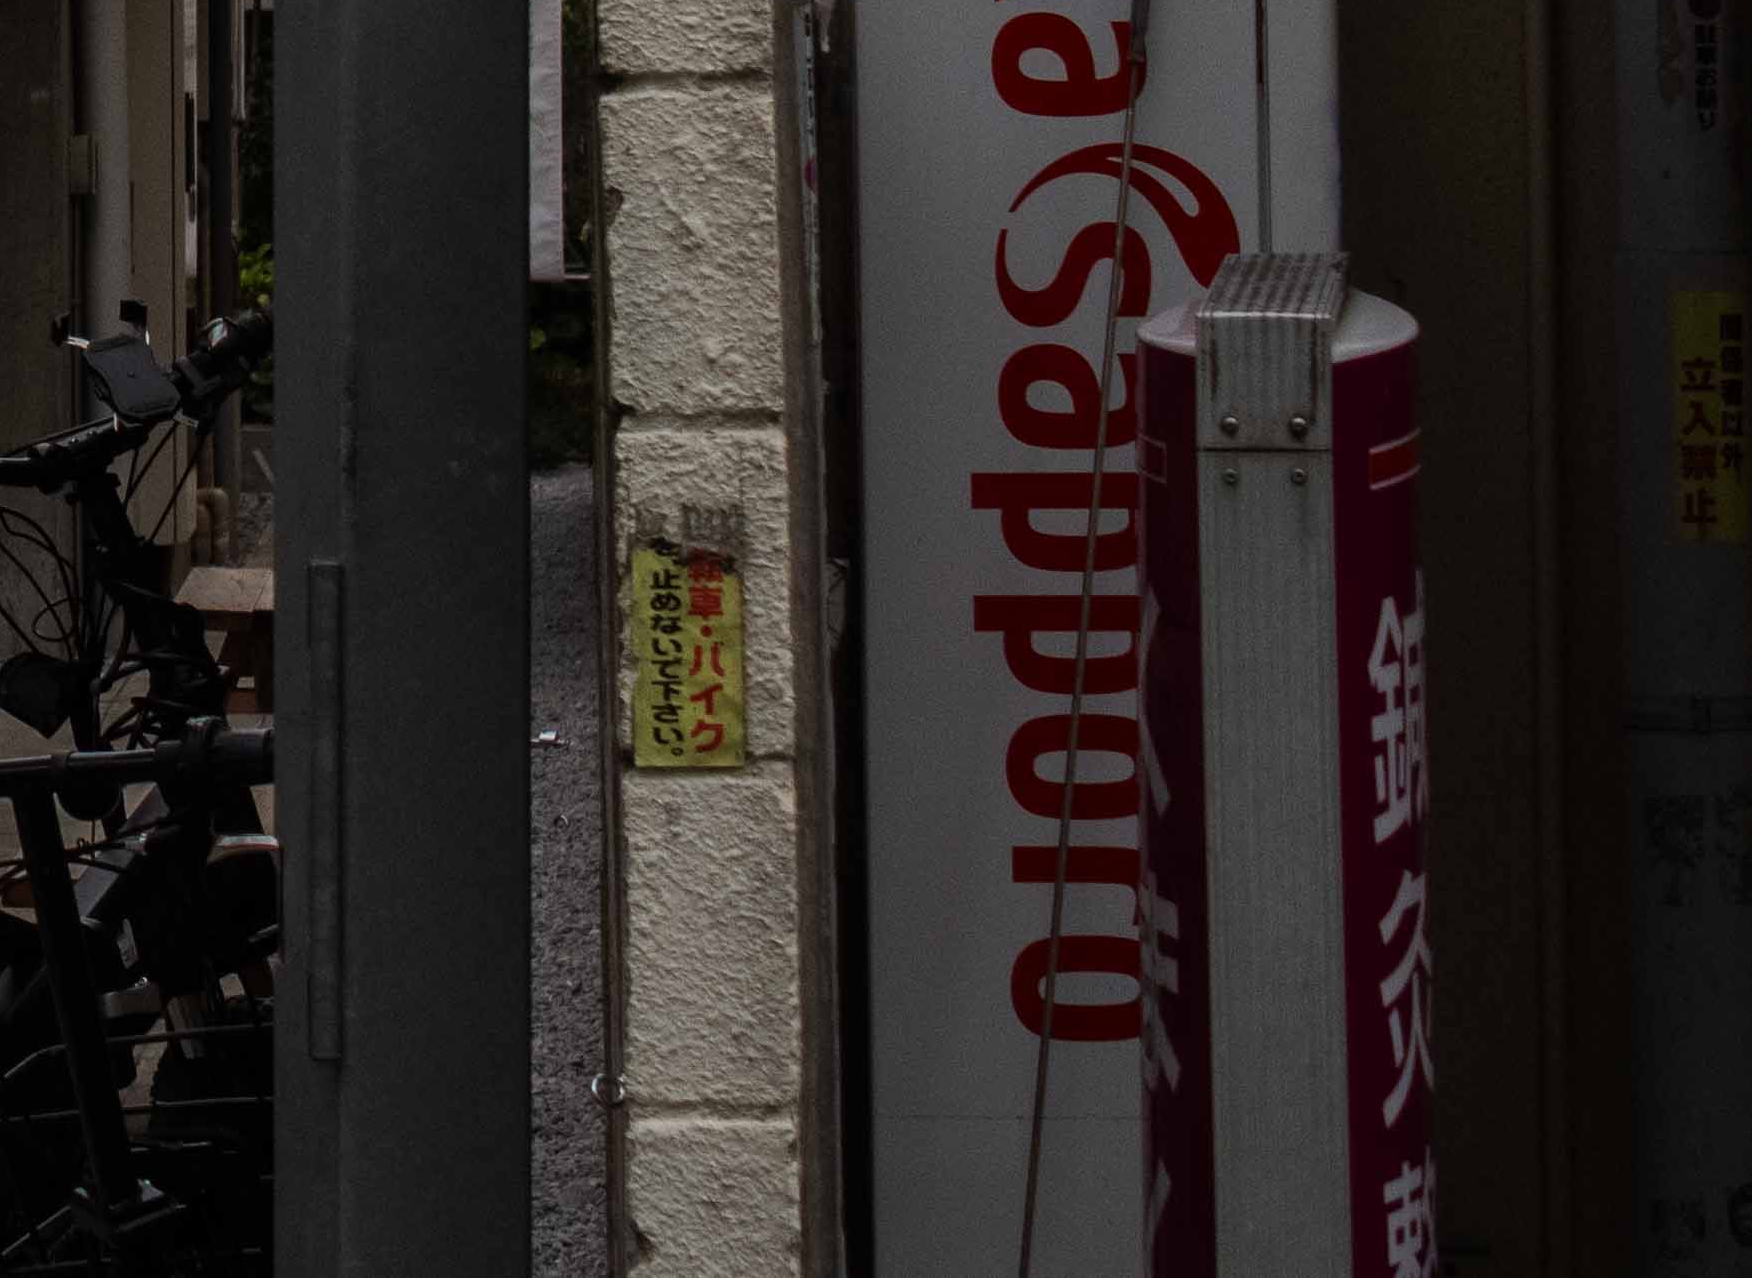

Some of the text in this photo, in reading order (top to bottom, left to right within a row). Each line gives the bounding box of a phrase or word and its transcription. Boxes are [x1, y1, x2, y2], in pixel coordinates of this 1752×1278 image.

[971, 220, 1151, 1044] Sapporo
[1680, 356, 1718, 527] 立入禁止
